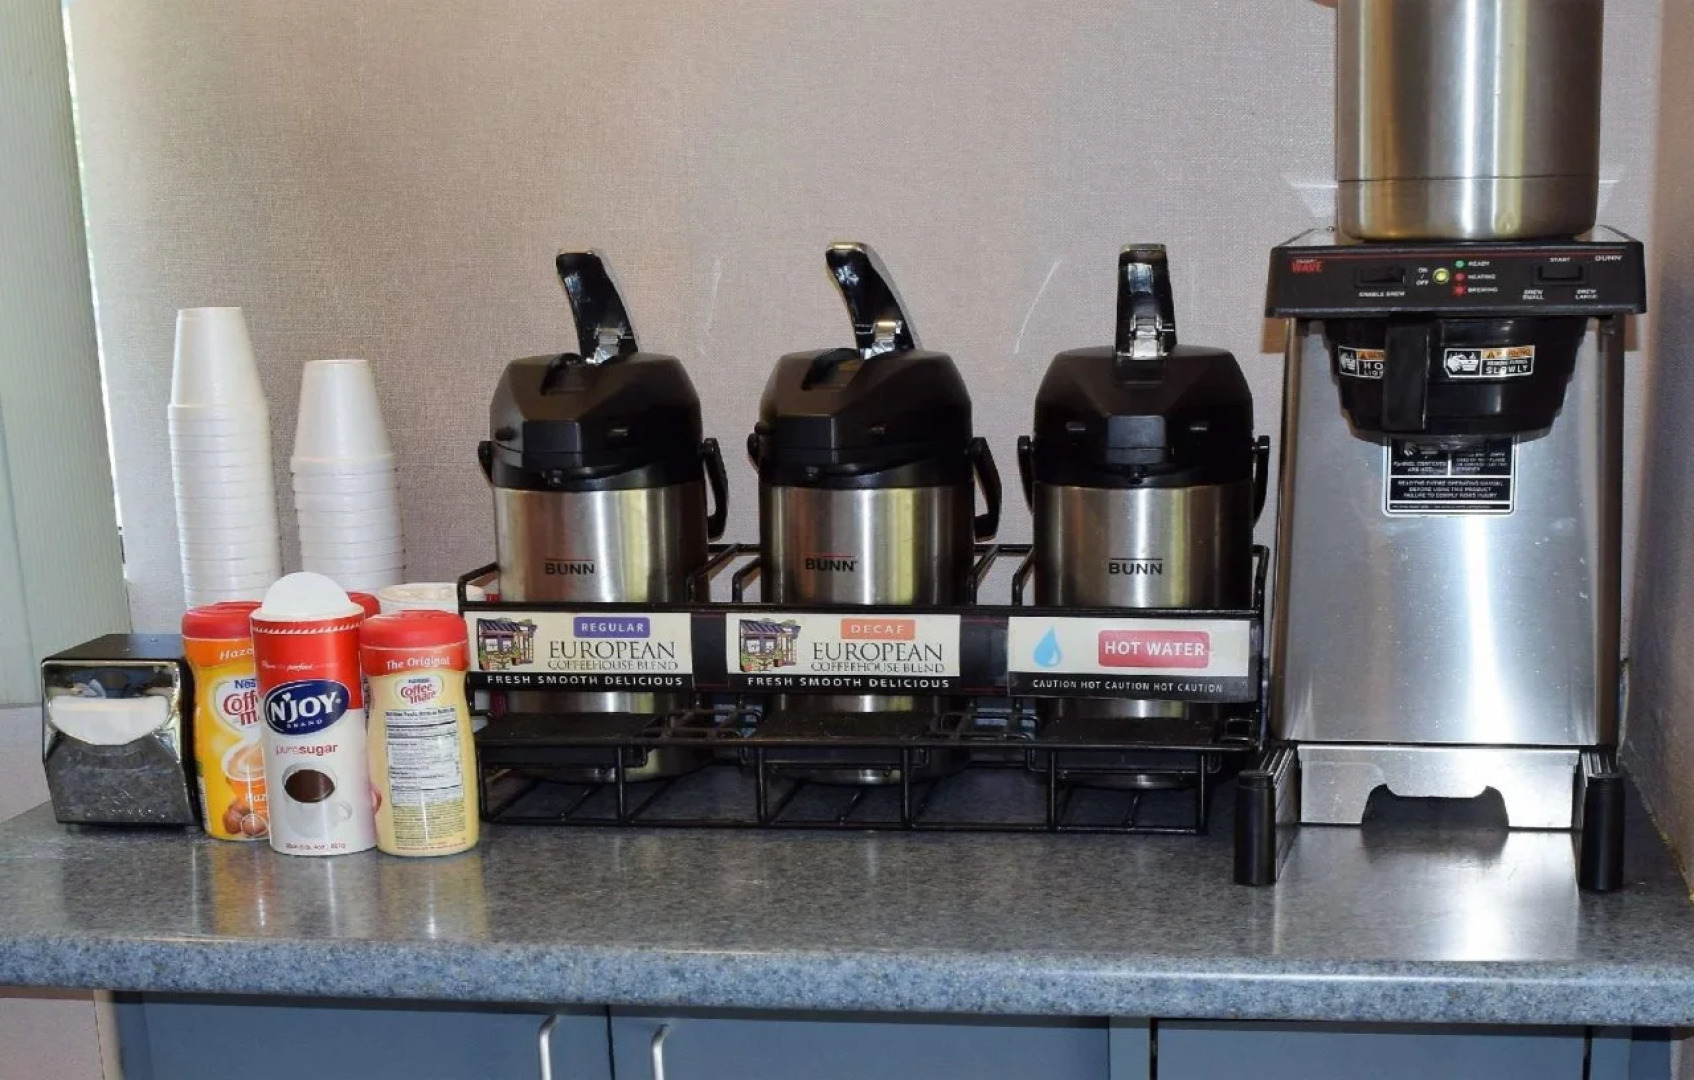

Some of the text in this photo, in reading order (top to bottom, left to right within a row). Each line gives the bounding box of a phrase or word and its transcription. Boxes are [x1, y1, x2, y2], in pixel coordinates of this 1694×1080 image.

[1292, 262, 1323, 273] WAVE
[1485, 364, 1528, 374] SLOWLY
[545, 562, 595, 575] BUNN
[805, 557, 856, 572] BUNN
[1109, 562, 1162, 575] BUNN
[580, 622, 645, 632] REGULAR
[850, 624, 905, 634] DECAF
[548, 641, 676, 660] EUROPEAN
[812, 642, 943, 661] EUROPEAN
[1104, 641, 1205, 656] HOT WATER
[386, 656, 451, 670] The Original
[547, 660, 679, 671] COFFEEHOUSE BLEND
[810, 661, 945, 673] COFFEEHOUSE BLEND
[487, 675, 683, 685] FRESH SMOOTH DELICIOUS
[747, 676, 950, 688] FRESH SMOOTH DELICIOUS
[1032, 679, 1223, 693] CAUTION HOT CAUTION HOT CAUTION
[400, 683, 433, 698] Coffee
[408, 690, 436, 704] mate
[286, 719, 323, 728] BRAND
